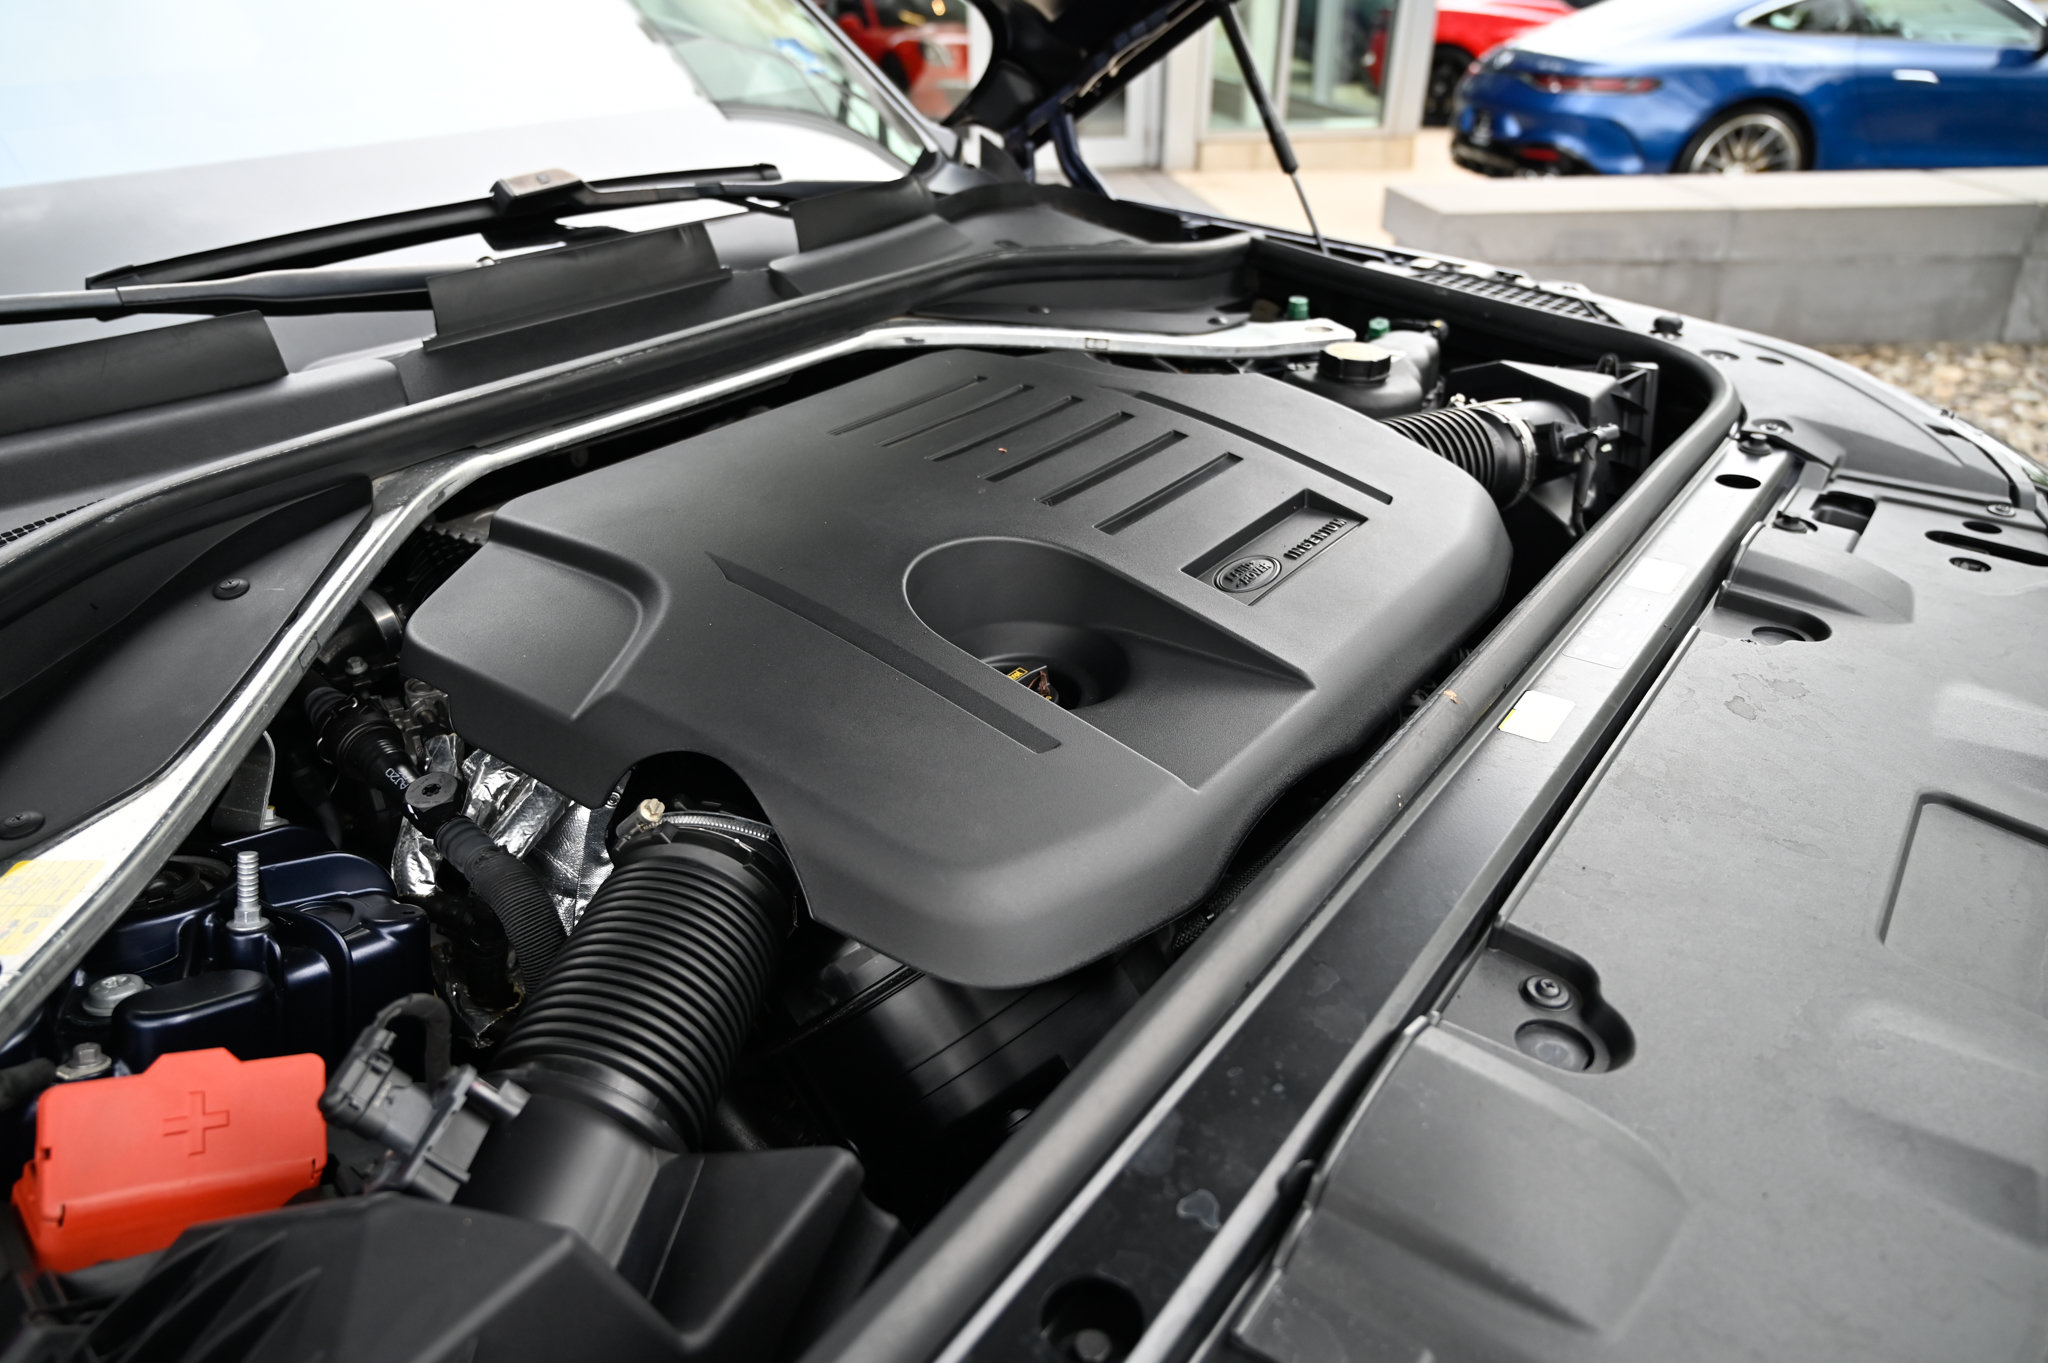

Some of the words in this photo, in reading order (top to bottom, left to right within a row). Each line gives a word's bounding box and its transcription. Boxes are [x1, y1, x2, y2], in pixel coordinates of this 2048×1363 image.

[1283, 518, 1348, 561] INGENIUM
[1224, 560, 1254, 582] LAND
[1239, 563, 1272, 587] ROVER
